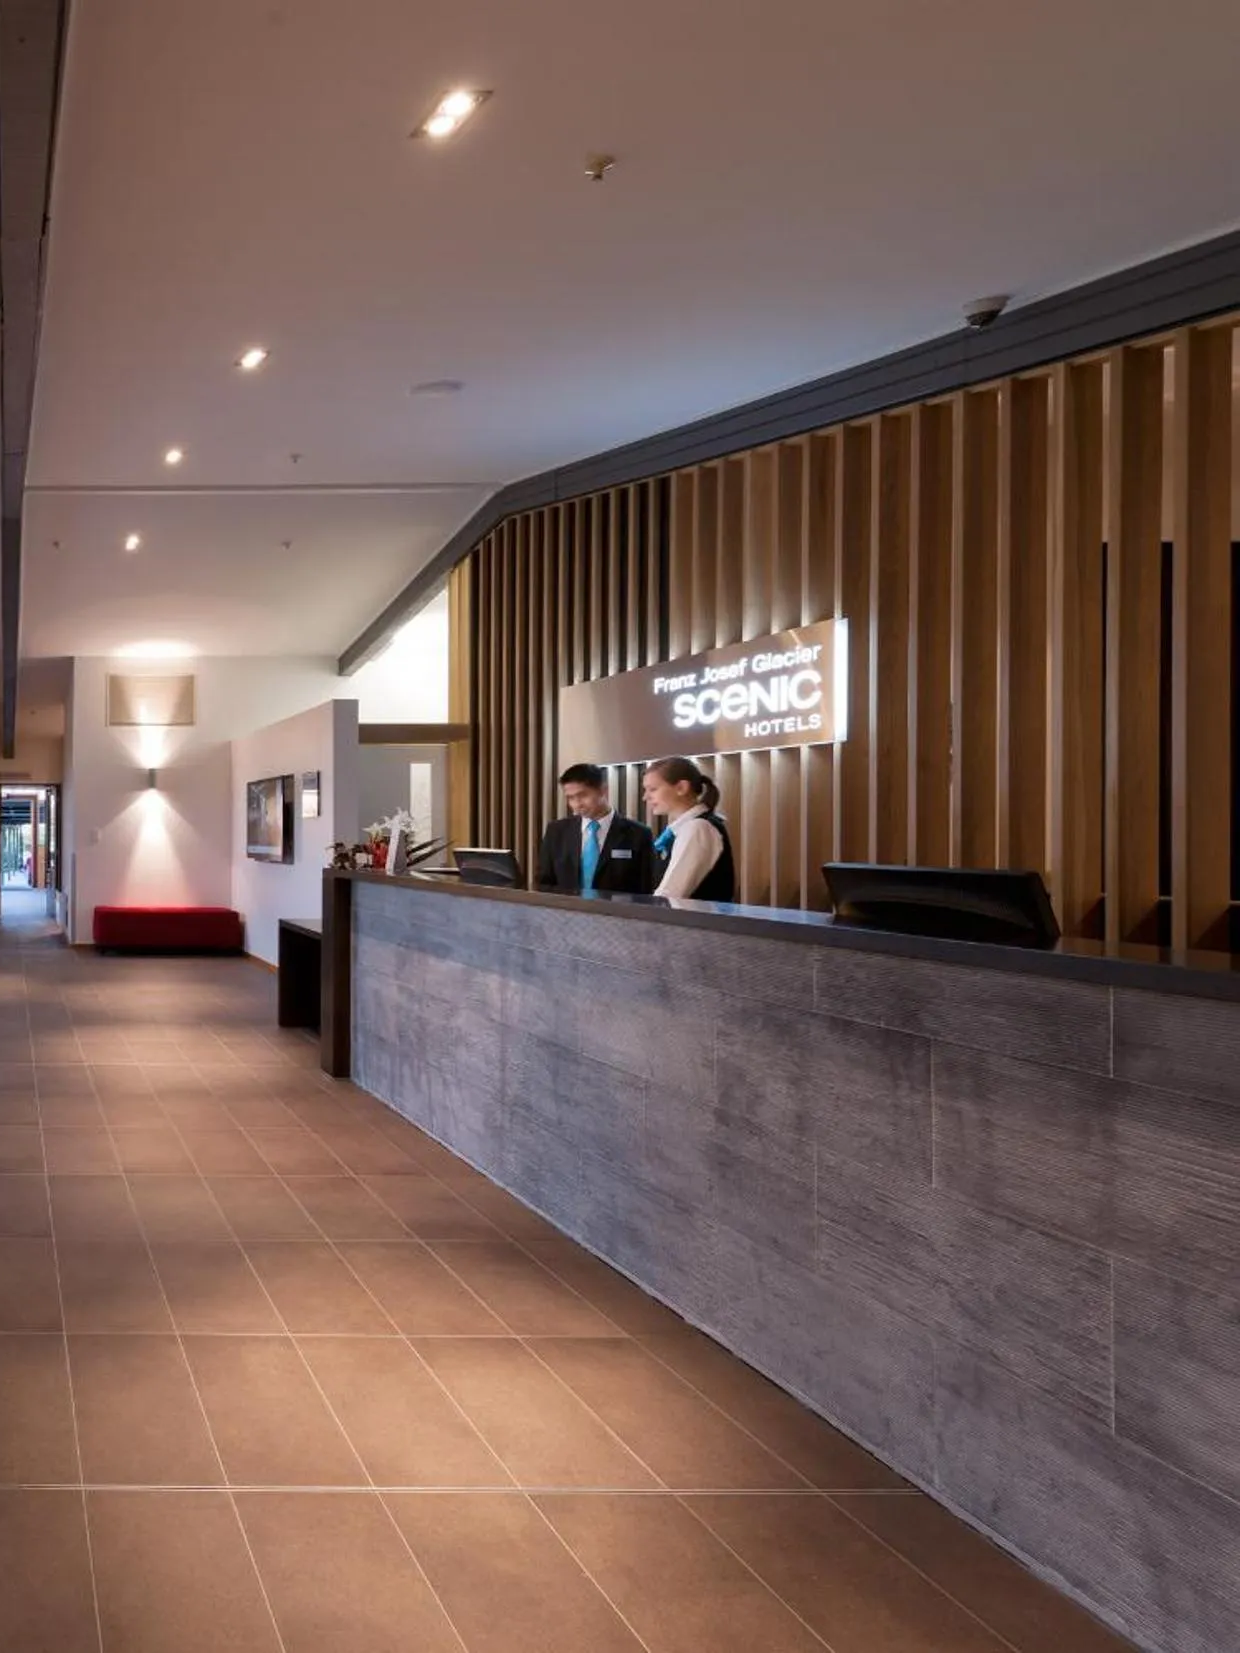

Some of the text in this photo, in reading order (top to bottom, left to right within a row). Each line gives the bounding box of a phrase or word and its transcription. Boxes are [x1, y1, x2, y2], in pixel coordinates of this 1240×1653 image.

[653, 644, 823, 696] Franz Josef Glacier
[744, 712, 822, 738] HOTELS
